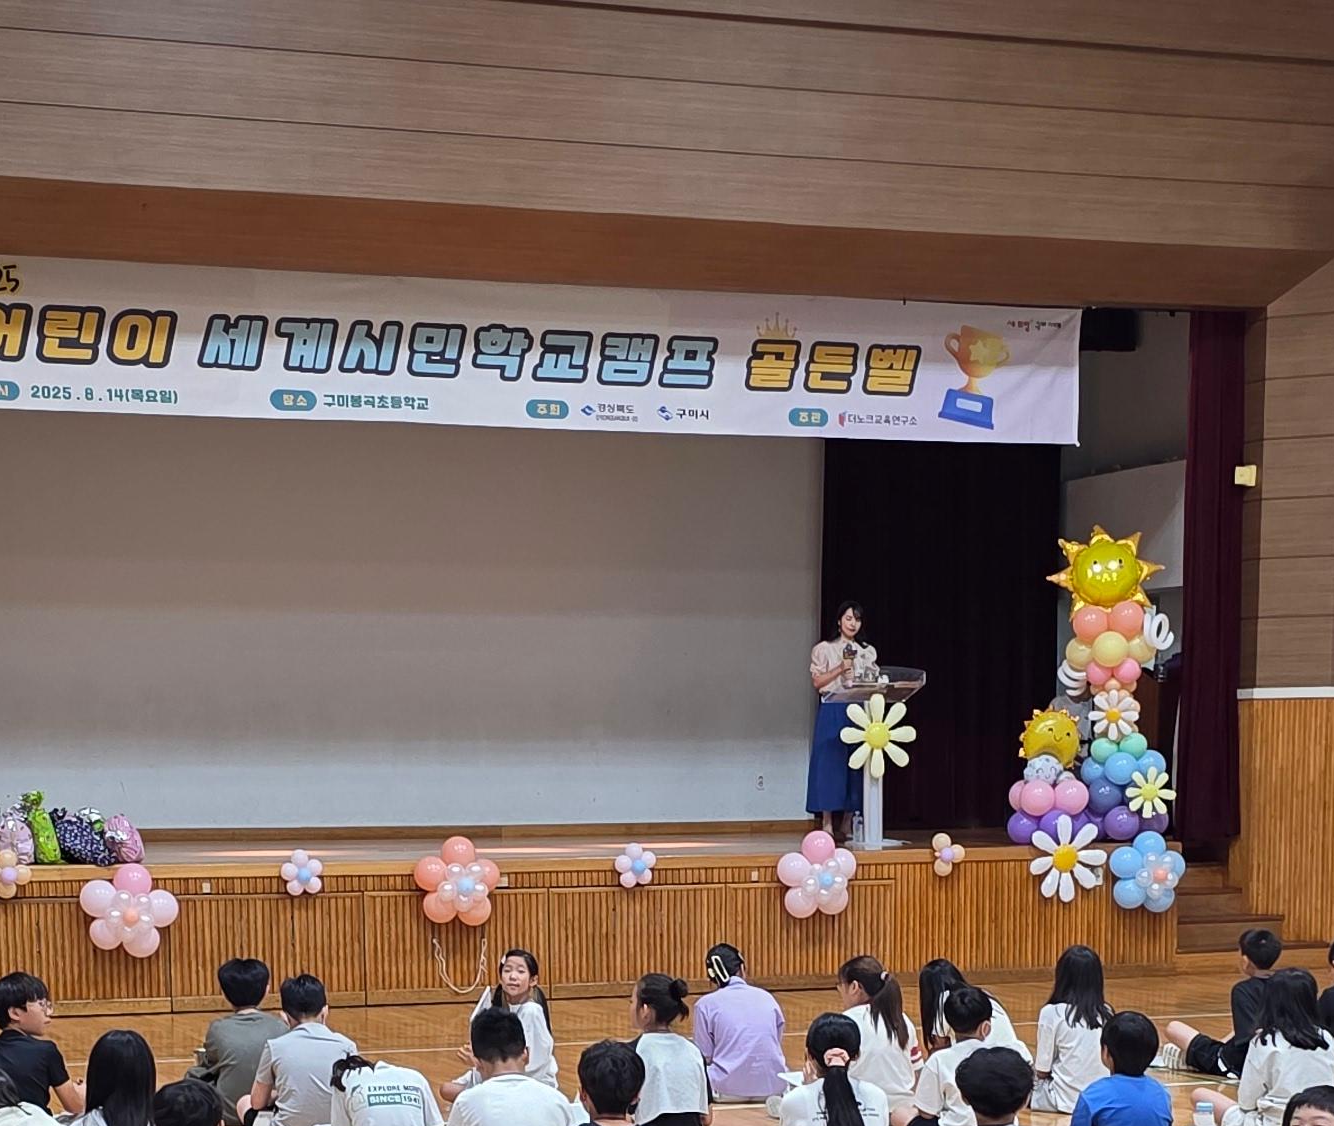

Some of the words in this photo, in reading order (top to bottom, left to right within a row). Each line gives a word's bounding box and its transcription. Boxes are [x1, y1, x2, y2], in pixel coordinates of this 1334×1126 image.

[745, 338, 923, 397] 골든벨
[598, 402, 635, 414] 경상북도
[676, 408, 709, 420] 구미시
[847, 413, 918, 426] 더노크교육연구소
[369, 1094, 401, 1104] SINCE
